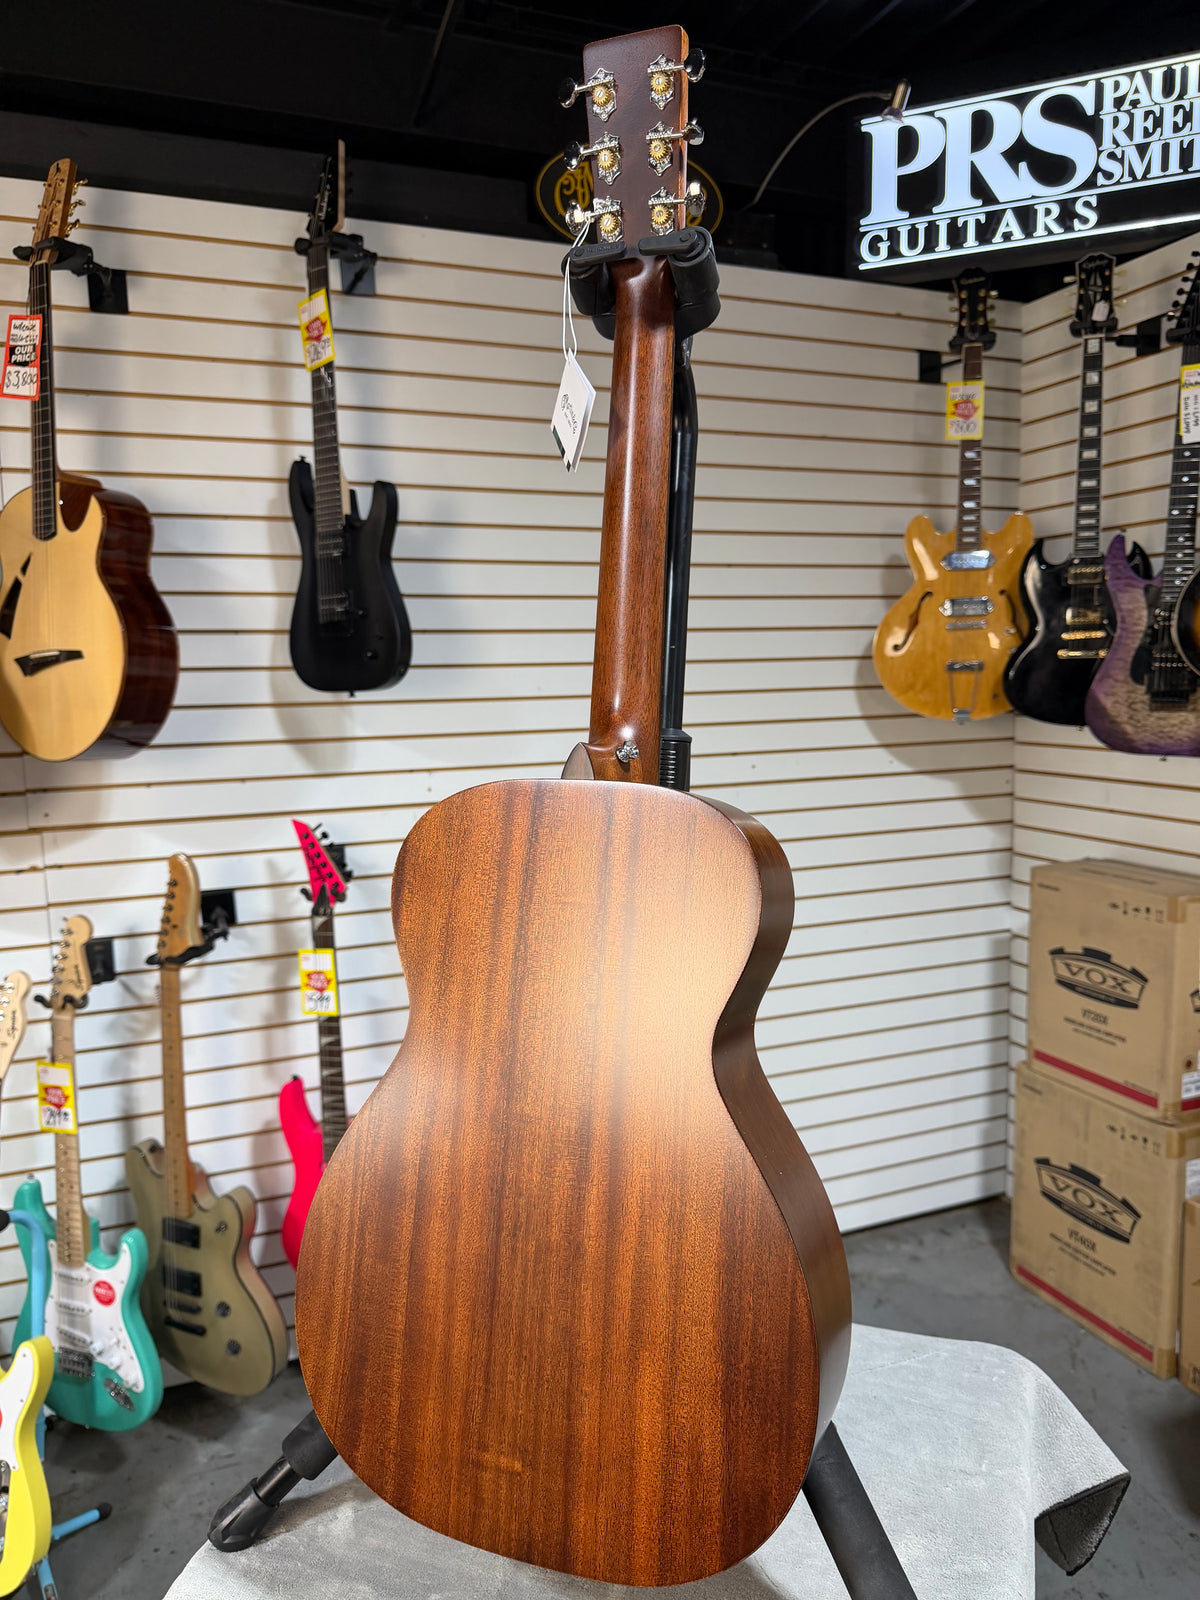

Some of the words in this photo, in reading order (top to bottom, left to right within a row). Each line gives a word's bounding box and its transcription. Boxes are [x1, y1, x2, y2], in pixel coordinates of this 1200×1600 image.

[1100, 62, 1200, 115] PAUL
[860, 80, 1098, 225] PRS
[859, 195, 1098, 263] GUITARS
[11, 352, 37, 363] PRICE
[14, 345, 34, 354] OUR
[1061, 960, 1134, 995] VOX
[1050, 1174, 1124, 1227] VOX
